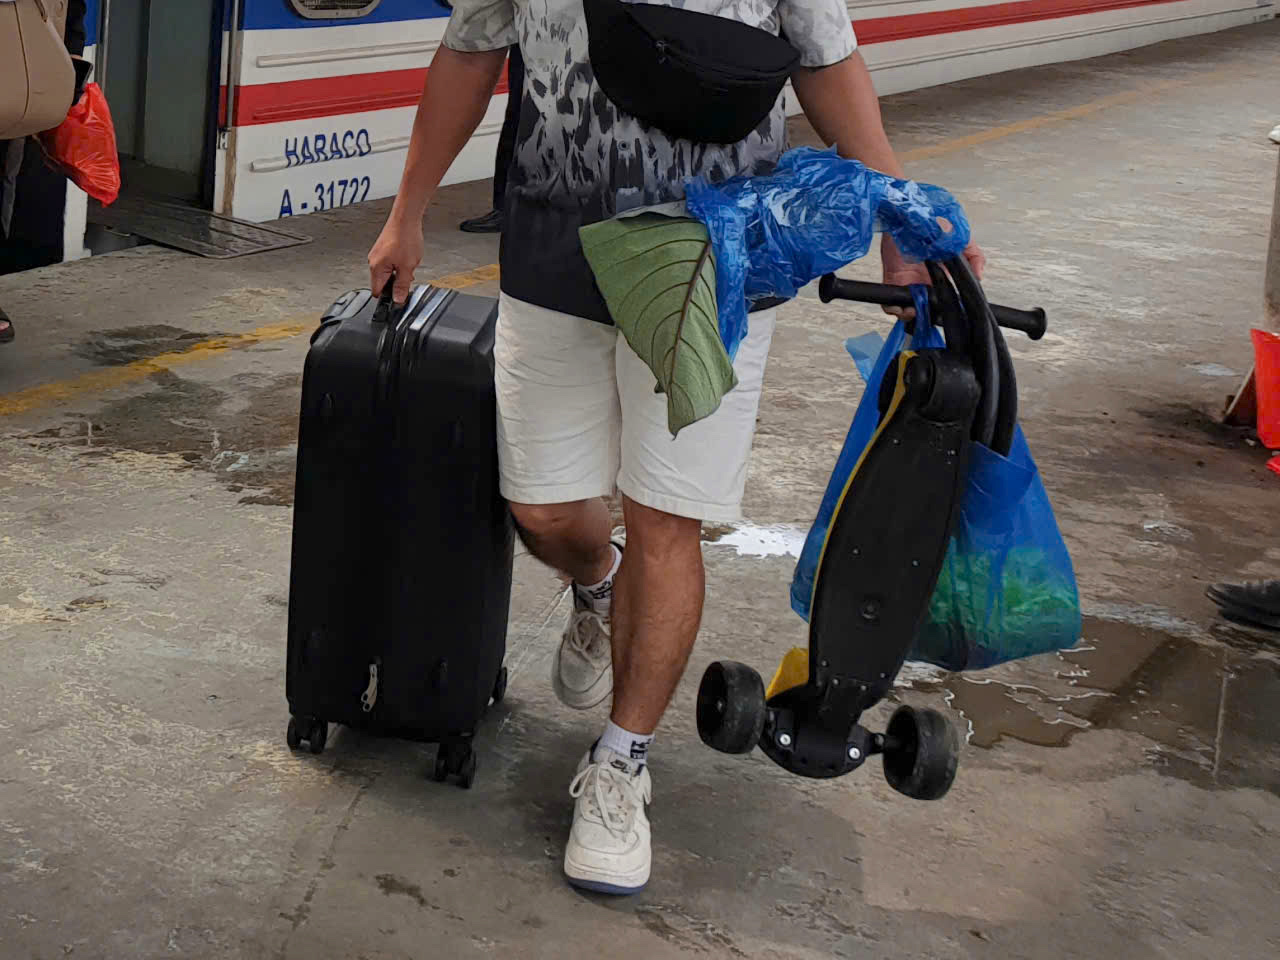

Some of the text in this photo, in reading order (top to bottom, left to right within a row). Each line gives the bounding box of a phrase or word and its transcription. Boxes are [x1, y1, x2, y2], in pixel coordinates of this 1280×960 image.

[285, 128, 371, 168] HARACO
[278, 189, 293, 219] A
[314, 176, 371, 214] 31722
